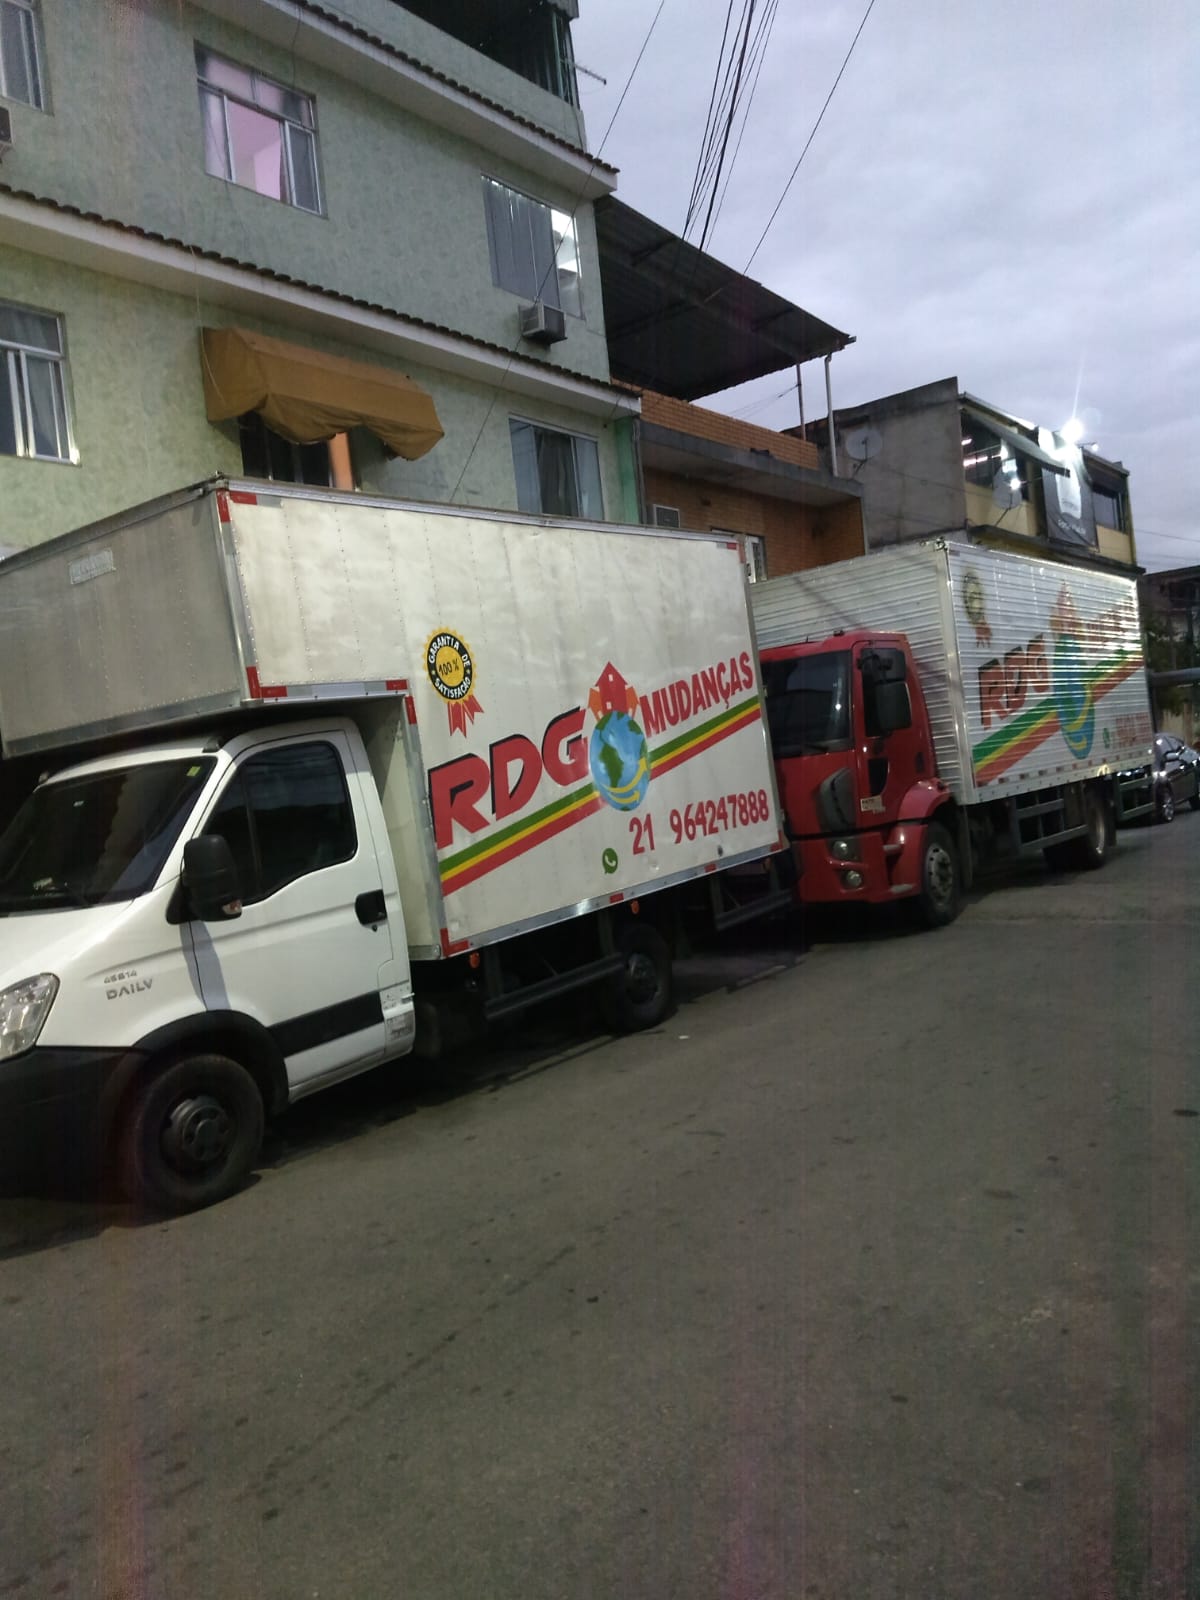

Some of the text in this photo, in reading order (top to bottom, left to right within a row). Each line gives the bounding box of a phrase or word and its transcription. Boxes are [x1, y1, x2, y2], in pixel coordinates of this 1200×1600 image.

[428, 635, 471, 667] GARANTIA DE
[977, 634, 1049, 730] RDG
[428, 652, 753, 849] RDG MUDANÇAS
[629, 789, 769, 855] 21 964247888
